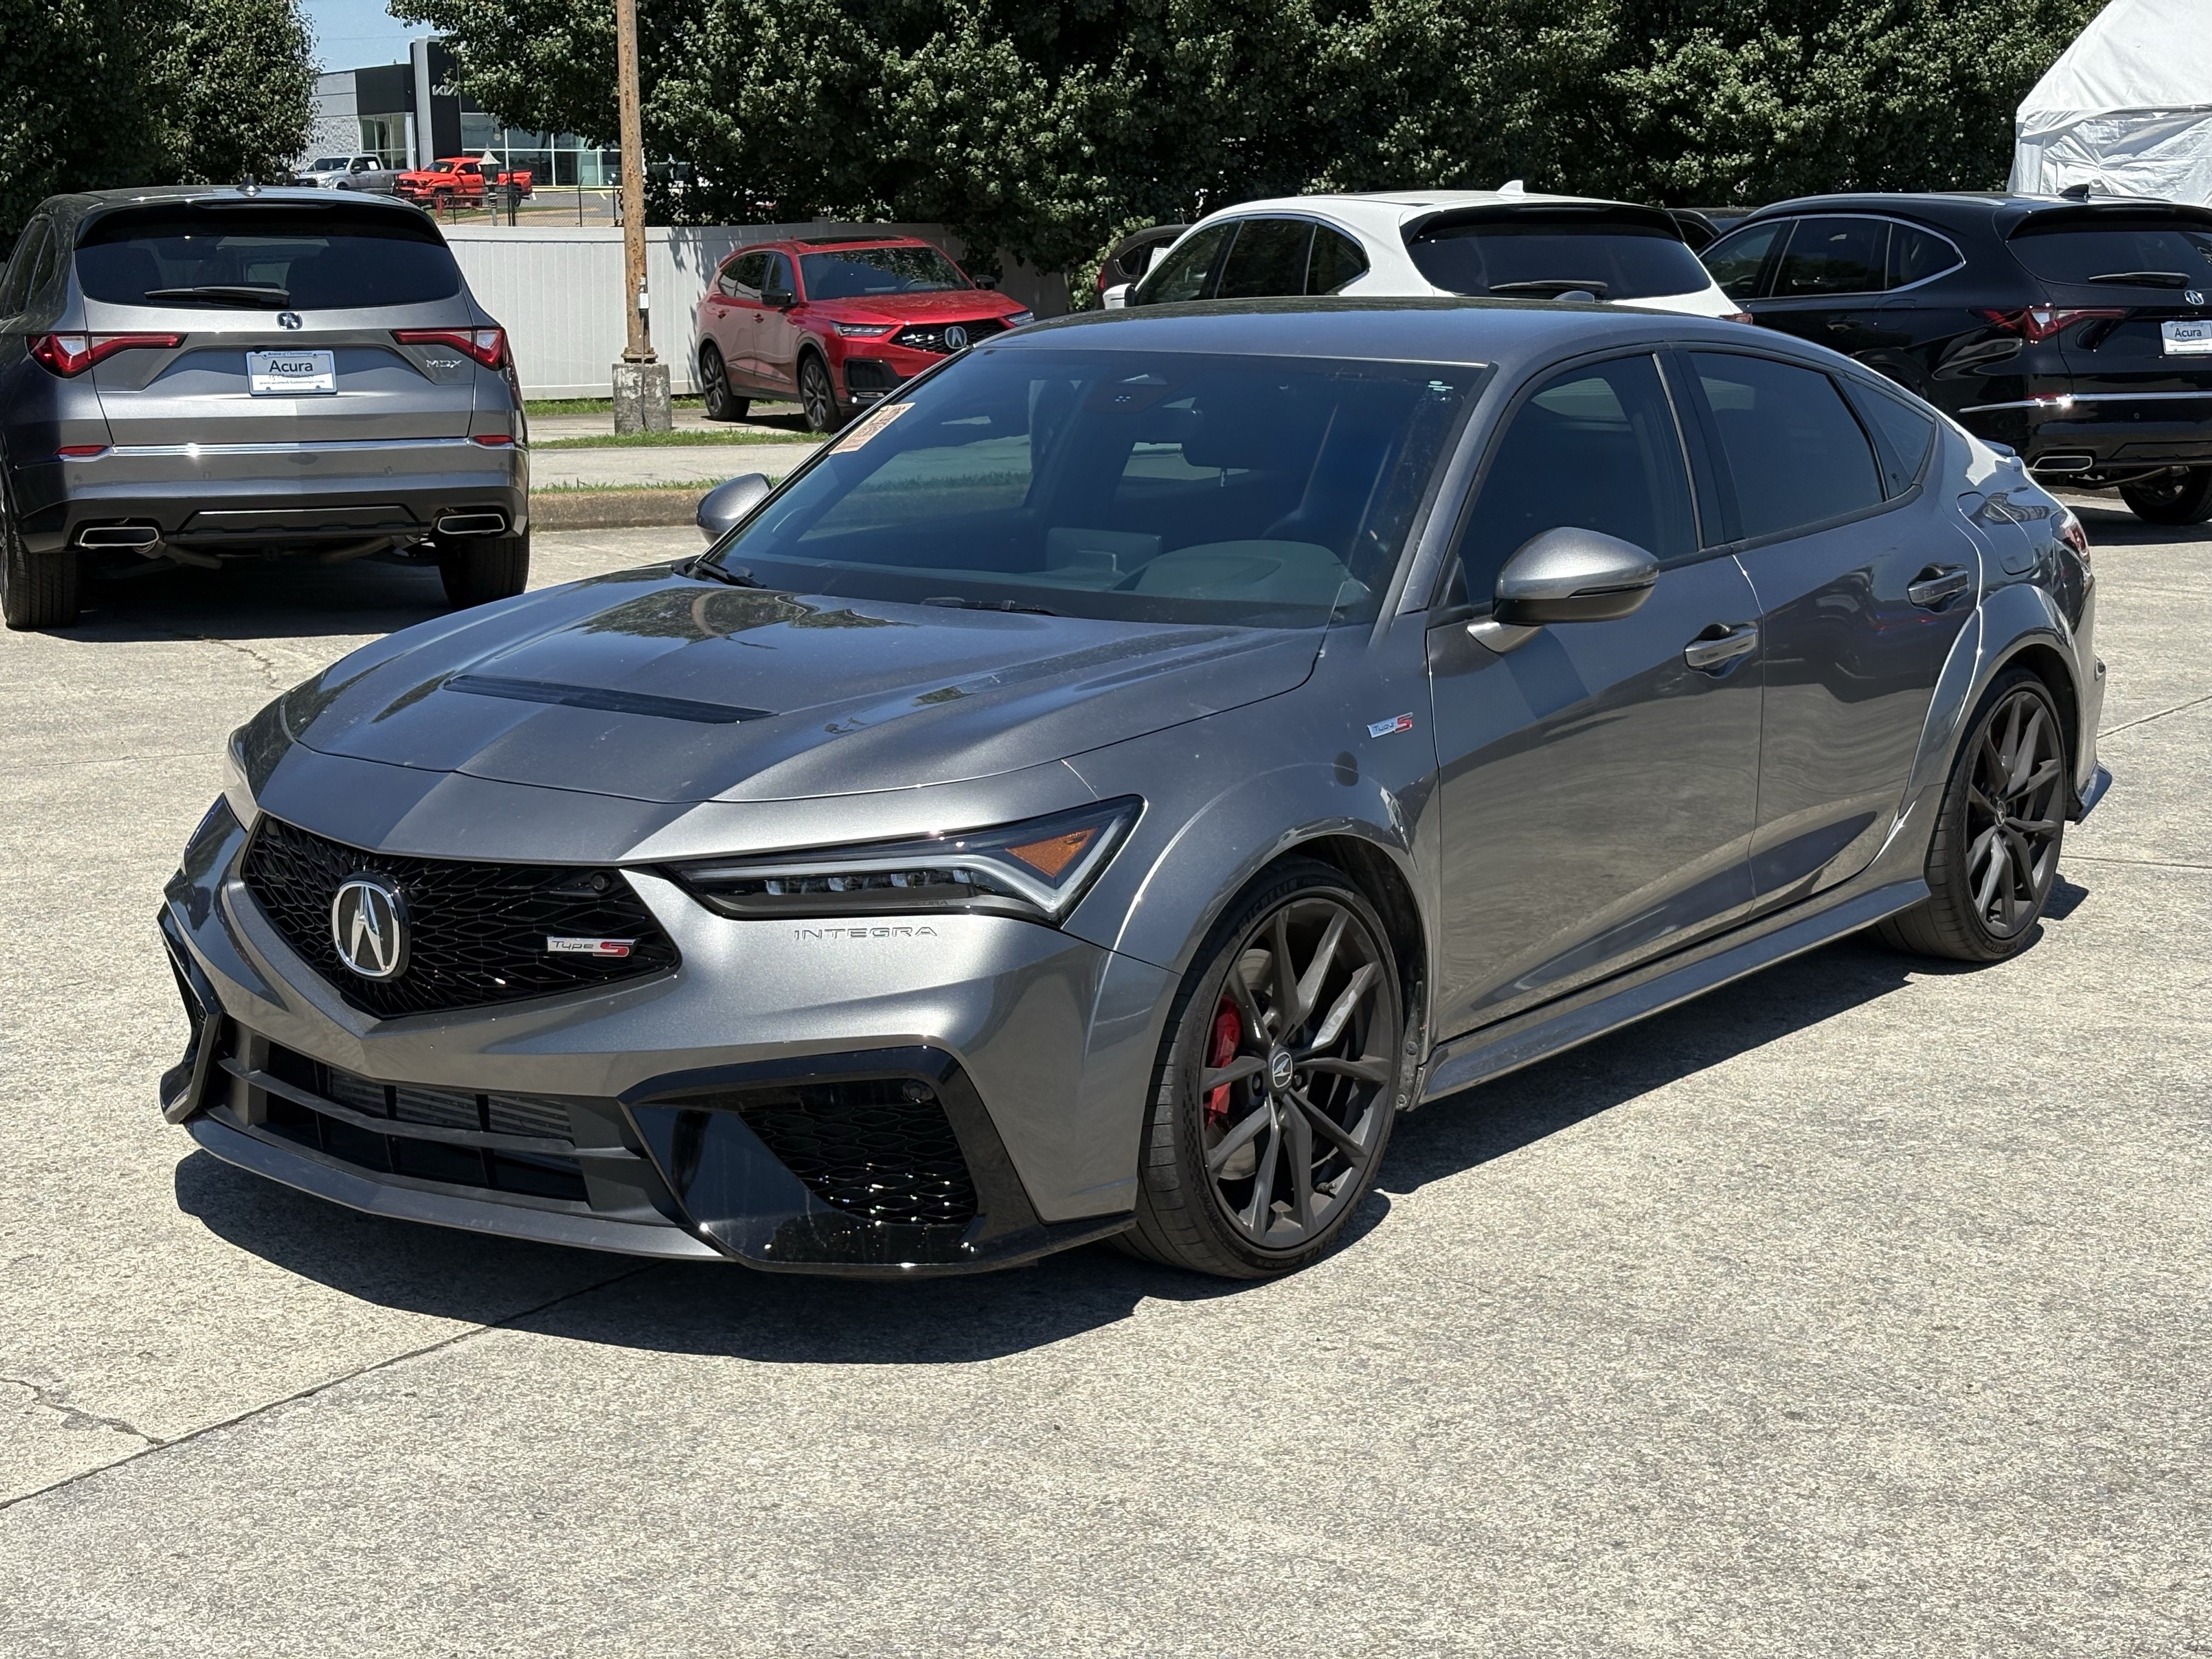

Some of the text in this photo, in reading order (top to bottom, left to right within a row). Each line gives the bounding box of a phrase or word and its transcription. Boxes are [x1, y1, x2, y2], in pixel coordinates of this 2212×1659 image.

[2175, 328, 2202, 337] Acura
[269, 360, 313, 373] Acura
[426, 359, 462, 368] MDX
[1394, 712, 1413, 733] S
[794, 927, 938, 940] INTEGRA
[551, 940, 634, 957] Type S
